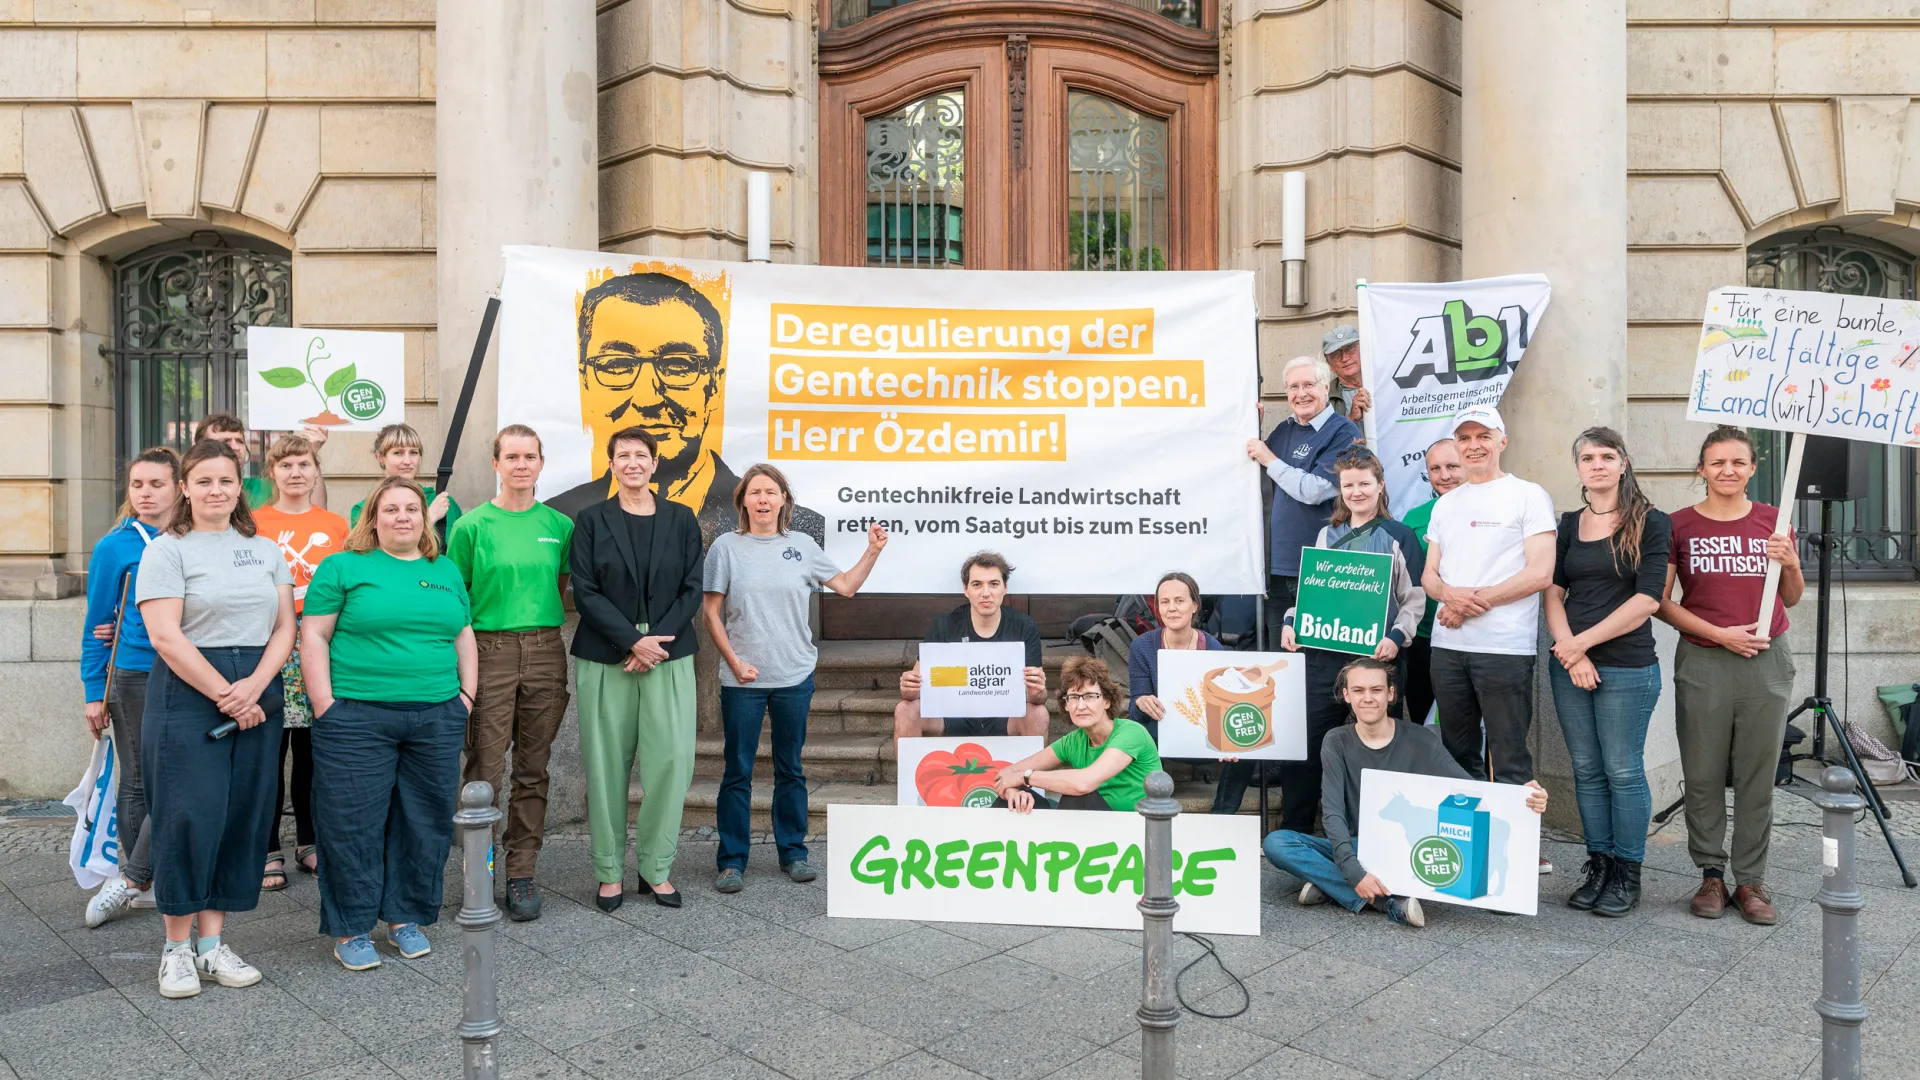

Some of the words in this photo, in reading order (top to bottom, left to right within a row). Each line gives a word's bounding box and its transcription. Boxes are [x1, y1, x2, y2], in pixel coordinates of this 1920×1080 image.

[1722, 292, 1762, 319] Für
[1775, 305, 1822, 324] eine
[1837, 298, 1904, 336] bunte,
[776, 313, 1071, 354] Deregulierung
[1080, 317, 1148, 349] der
[774, 362, 1013, 401] Gentechnik
[1021, 367, 1200, 407] stoppen,
[1400, 381, 1504, 405] Arbeitsgemeinschaft
[347, 387, 373, 403] GEN
[353, 400, 376, 412] FREI
[1401, 403, 1455, 416] bäuerliche
[774, 418, 864, 453] Herr
[874, 411, 1059, 453] Özdemir!
[837, 486, 1013, 504] Gentechnikfreie
[1018, 487, 1181, 506] Landwirtschaft
[914, 519, 960, 533] vom
[965, 516, 1048, 539] Saatgut
[1053, 516, 1085, 535] bis
[1088, 520, 1134, 535] zum
[1138, 517, 1208, 535] Essen!
[1689, 535, 1742, 555] ESSEN
[1748, 538, 1768, 554] IST
[1316, 561, 1334, 572] Wir
[1334, 563, 1375, 577] arbeiten
[1690, 555, 1768, 574] POLITISCH
[1304, 574, 1326, 587] ohne
[1327, 576, 1385, 595] Gentechnik!
[1300, 612, 1378, 647] Bioland
[969, 664, 1012, 676] aktion
[969, 677, 1006, 689] agrar
[1229, 711, 1254, 729] GEN
[1235, 725, 1257, 738] FREI
[1440, 825, 1471, 838] MILCH
[849, 834, 1237, 897] GREENPEAE
[1418, 847, 1448, 865] GEN
[1424, 864, 1451, 875] FREI
